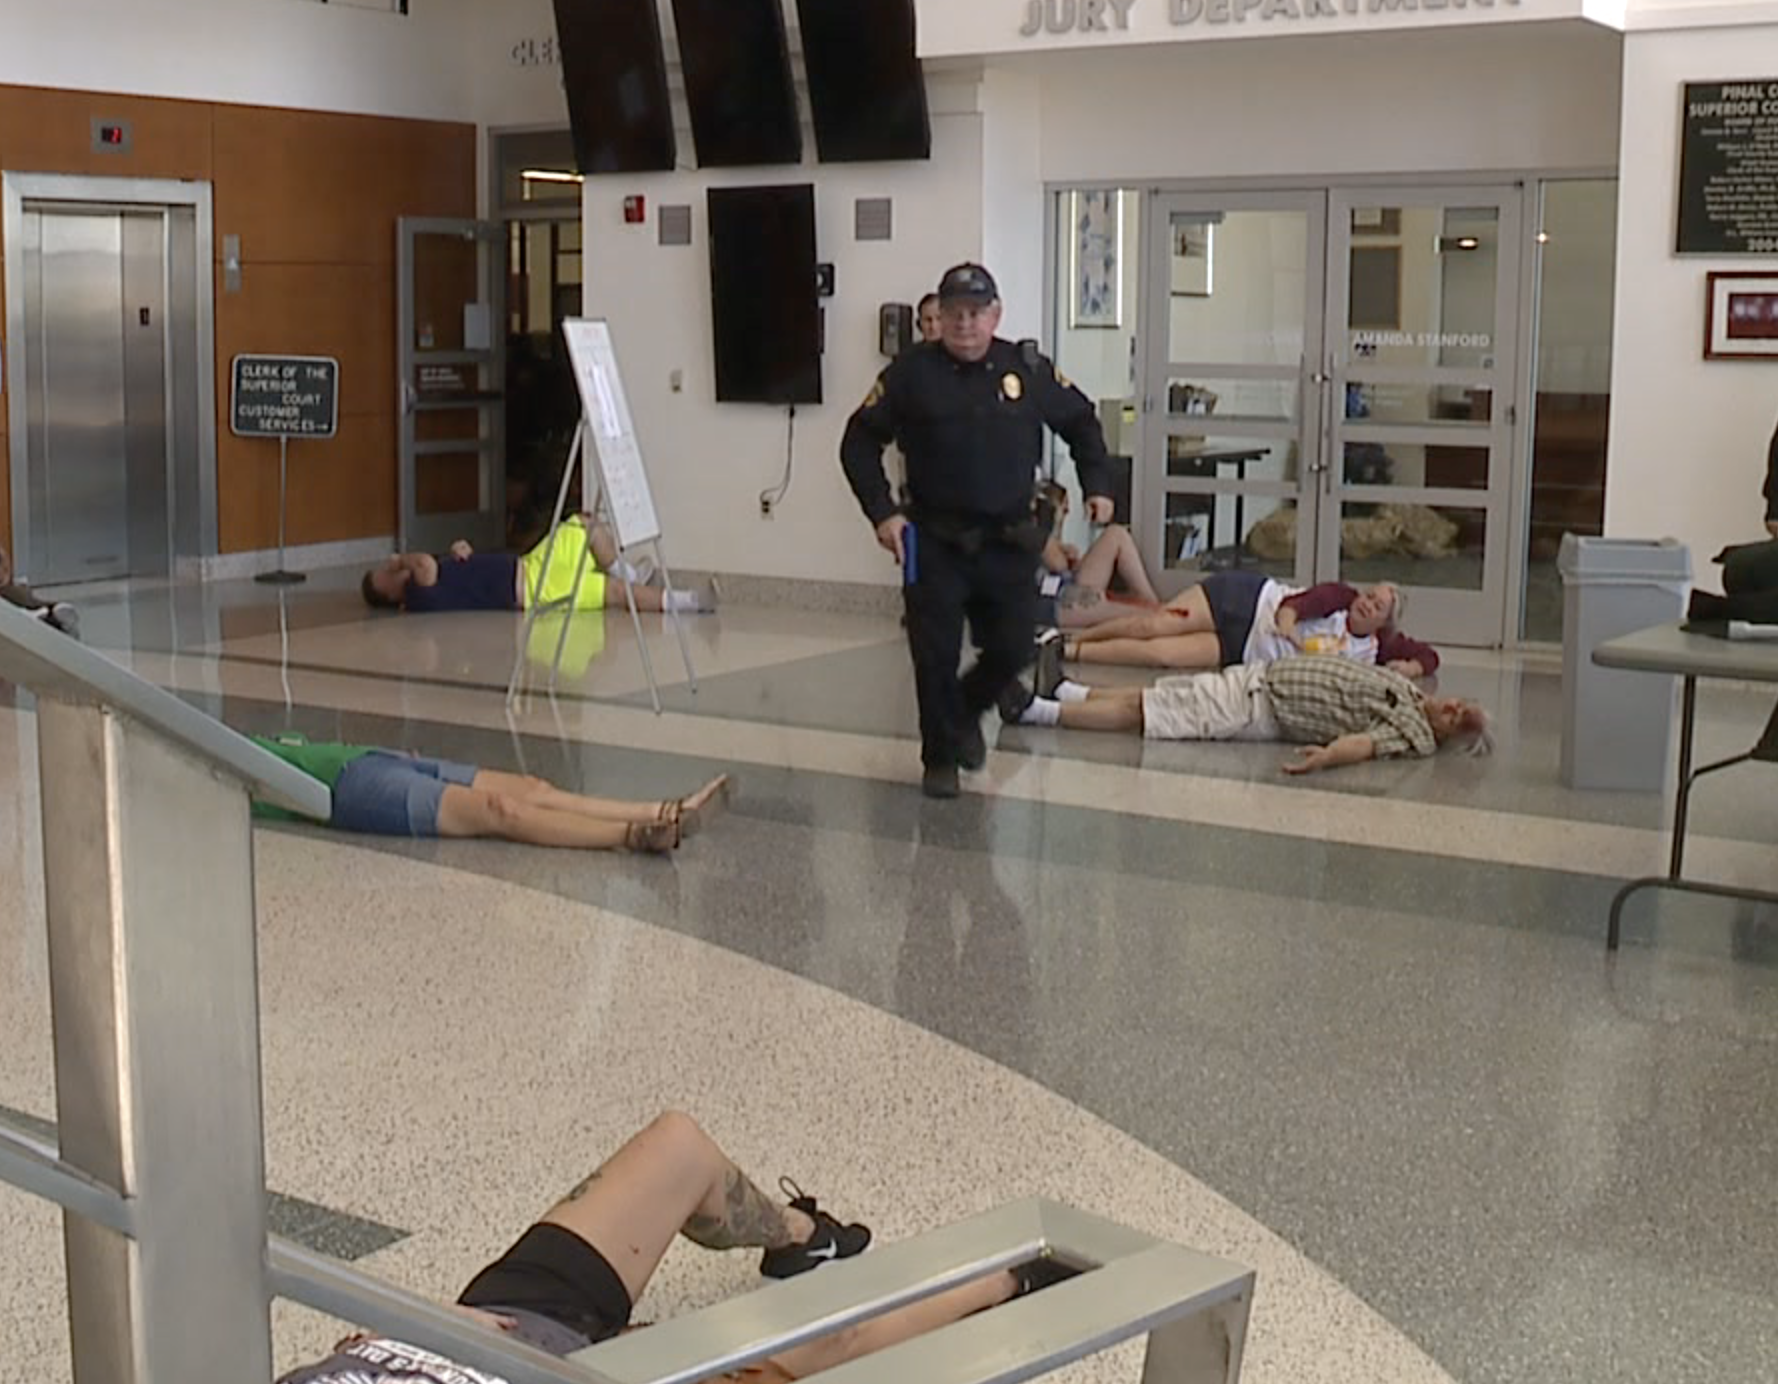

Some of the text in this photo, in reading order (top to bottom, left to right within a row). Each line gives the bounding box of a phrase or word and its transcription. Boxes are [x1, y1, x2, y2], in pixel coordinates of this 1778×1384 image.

[1019, 0, 1521, 36] JURY DEPAR
[1722, 84, 1765, 101] PINAL
[1689, 101, 1758, 117] SUPERIOR
[1417, 333, 1490, 347] STANFORD
[241, 364, 328, 379] CLERK OF THE
[241, 379, 297, 392] SUPERIOR
[282, 393, 322, 406] COURT
[239, 404, 299, 418] CUSTOMER
[259, 418, 315, 431] SERVICES
